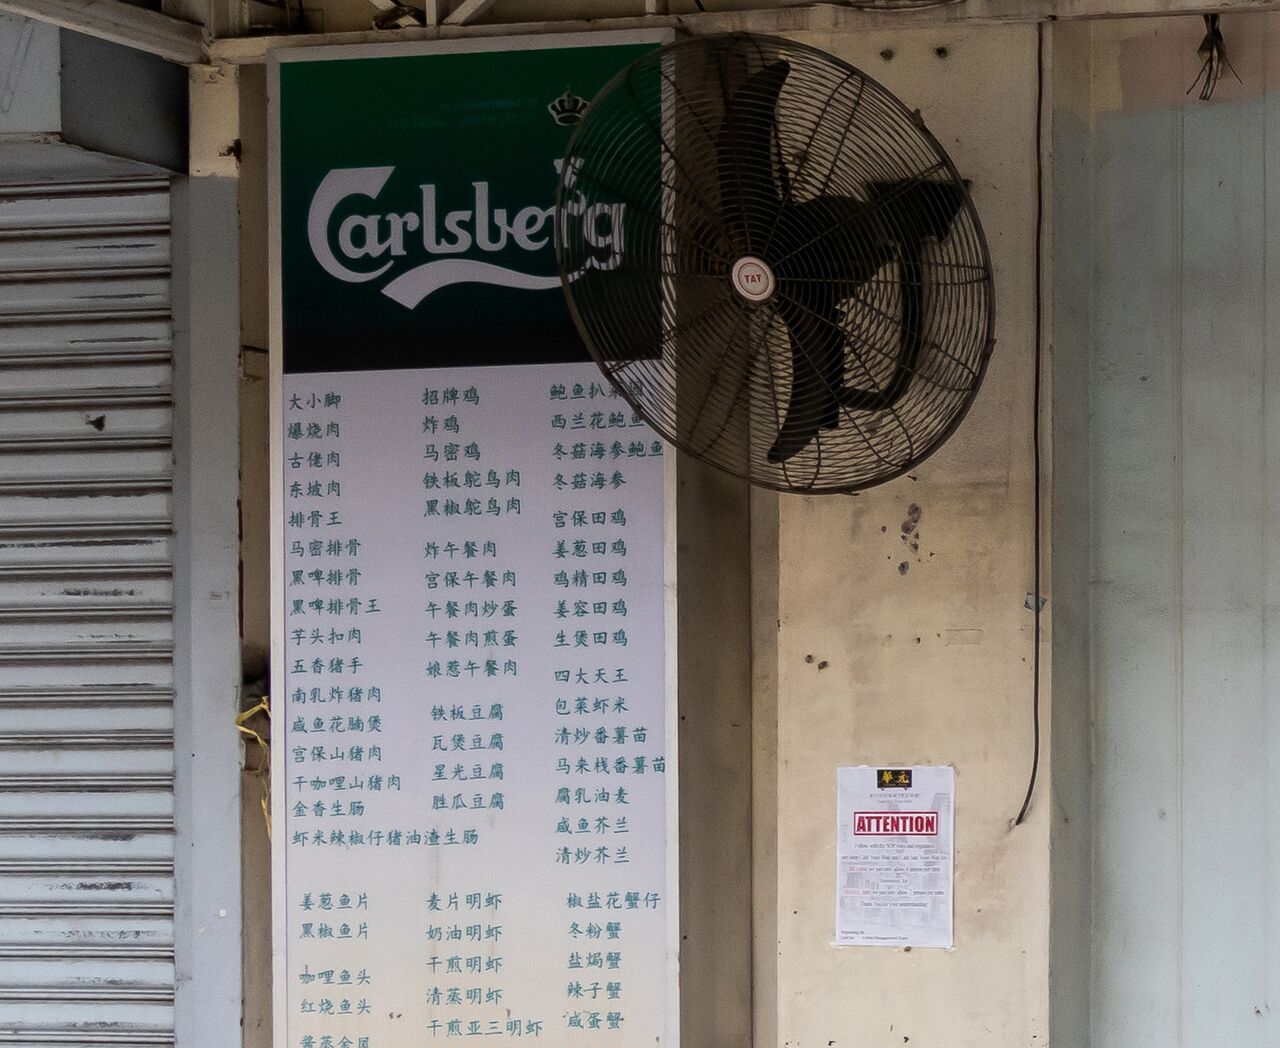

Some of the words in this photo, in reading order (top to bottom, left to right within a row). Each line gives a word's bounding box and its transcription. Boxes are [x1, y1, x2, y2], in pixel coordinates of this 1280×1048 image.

[307, 164, 627, 283] Carlsberg
[289, 391, 342, 409] 大小脚
[421, 386, 480, 405] 招牌鸡
[422, 415, 460, 434] 炸鸡
[551, 411, 645, 430] 西兰花鲍鱼
[423, 442, 481, 462] 马密鸡
[552, 440, 664, 460] 冬菇海参鲍鱼
[289, 480, 341, 498] 东坡肉
[552, 471, 628, 490] 冬菇海参
[287, 511, 342, 528] 排骨王
[552, 508, 627, 528] 宫保田鸡
[290, 539, 362, 557] 马密排骨
[424, 541, 497, 559] 炸午餐肉
[551, 539, 628, 558] 姜葱田鸡
[289, 568, 362, 586] 黑啤排骨
[424, 570, 516, 589] 宫保午餐肉
[553, 569, 628, 588] 鸡精田鸡
[289, 598, 382, 616] 黑啤排骨王
[424, 600, 518, 619] 午餐肉炒蛋
[290, 627, 362, 645] 芋头扣肉
[425, 630, 519, 648] 午餐肉煎蛋
[553, 629, 628, 647] 生煲田鸡
[290, 657, 363, 674] 五香猪手
[425, 659, 517, 678] 娘惹午餐肉
[554, 668, 629, 684] 四大天王
[291, 686, 381, 704] 南乳炸猪肉
[431, 704, 504, 720] 铁板豆腐
[555, 697, 629, 715] 包菜虾米
[432, 733, 504, 751] 瓦煲豆腐
[554, 727, 648, 745] 清炒番薯苗
[292, 745, 382, 762] 宫保山猪肉
[431, 763, 505, 781] 星光豆腐
[431, 792, 505, 810] 胜瓜豆腐
[555, 787, 630, 804] 腐乳油麦
[293, 800, 365, 817] 金香生肠
[555, 817, 630, 834] 咸鱼芥兰
[856, 815, 935, 832] ATTENTION
[555, 846, 630, 864] 清炒芥兰
[299, 893, 368, 910] 姜葱鱼片
[426, 892, 502, 911] 麦片明虾
[566, 892, 662, 909] 椒盐花蟹仔
[299, 922, 368, 939] 黑椒鱼片
[425, 925, 503, 941] 奶油明虾
[568, 922, 622, 939] 冬粉蟹
[426, 956, 503, 973] 干煎明虾
[426, 987, 503, 1005] 清蒸明虾
[566, 981, 622, 999] 辣子蟹
[301, 999, 371, 1016] 红烧鱼头
[426, 1019, 543, 1036] 干煎亚三明虾
[568, 1012, 622, 1029] 咸蛋蟹
